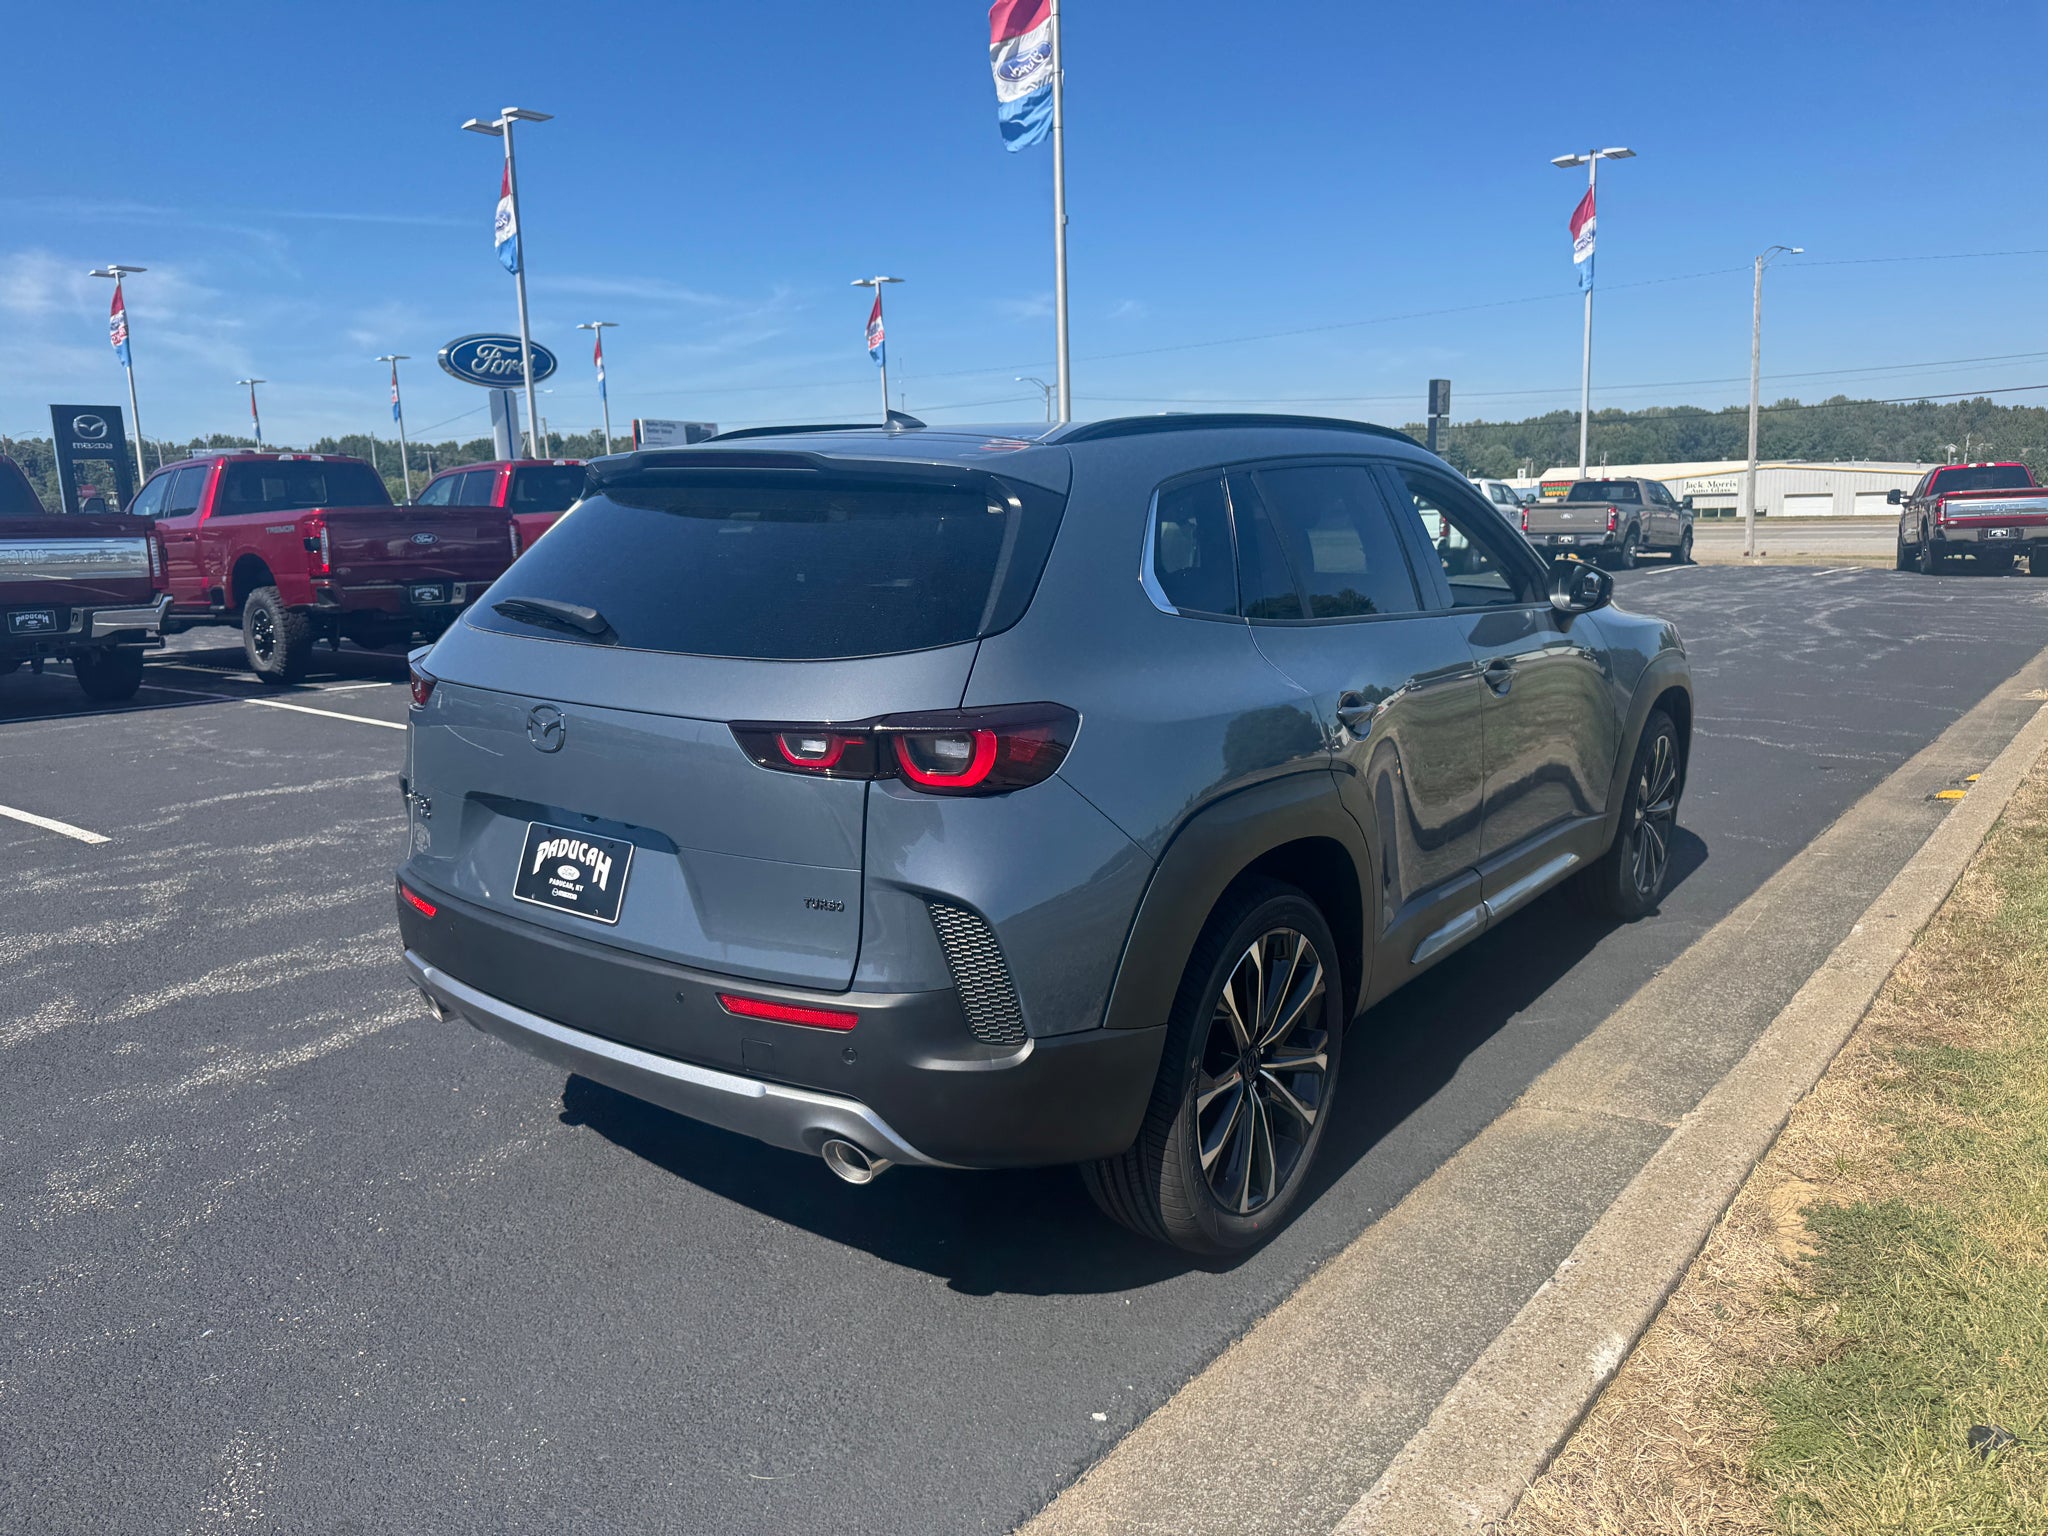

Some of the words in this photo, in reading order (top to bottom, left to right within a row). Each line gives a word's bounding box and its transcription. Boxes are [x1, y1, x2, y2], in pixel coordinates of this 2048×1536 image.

[1685, 481, 1703, 490] Jack
[1707, 480, 1737, 488] Morris
[532, 839, 612, 891] PADUCAH
[803, 897, 845, 912] TURBO
